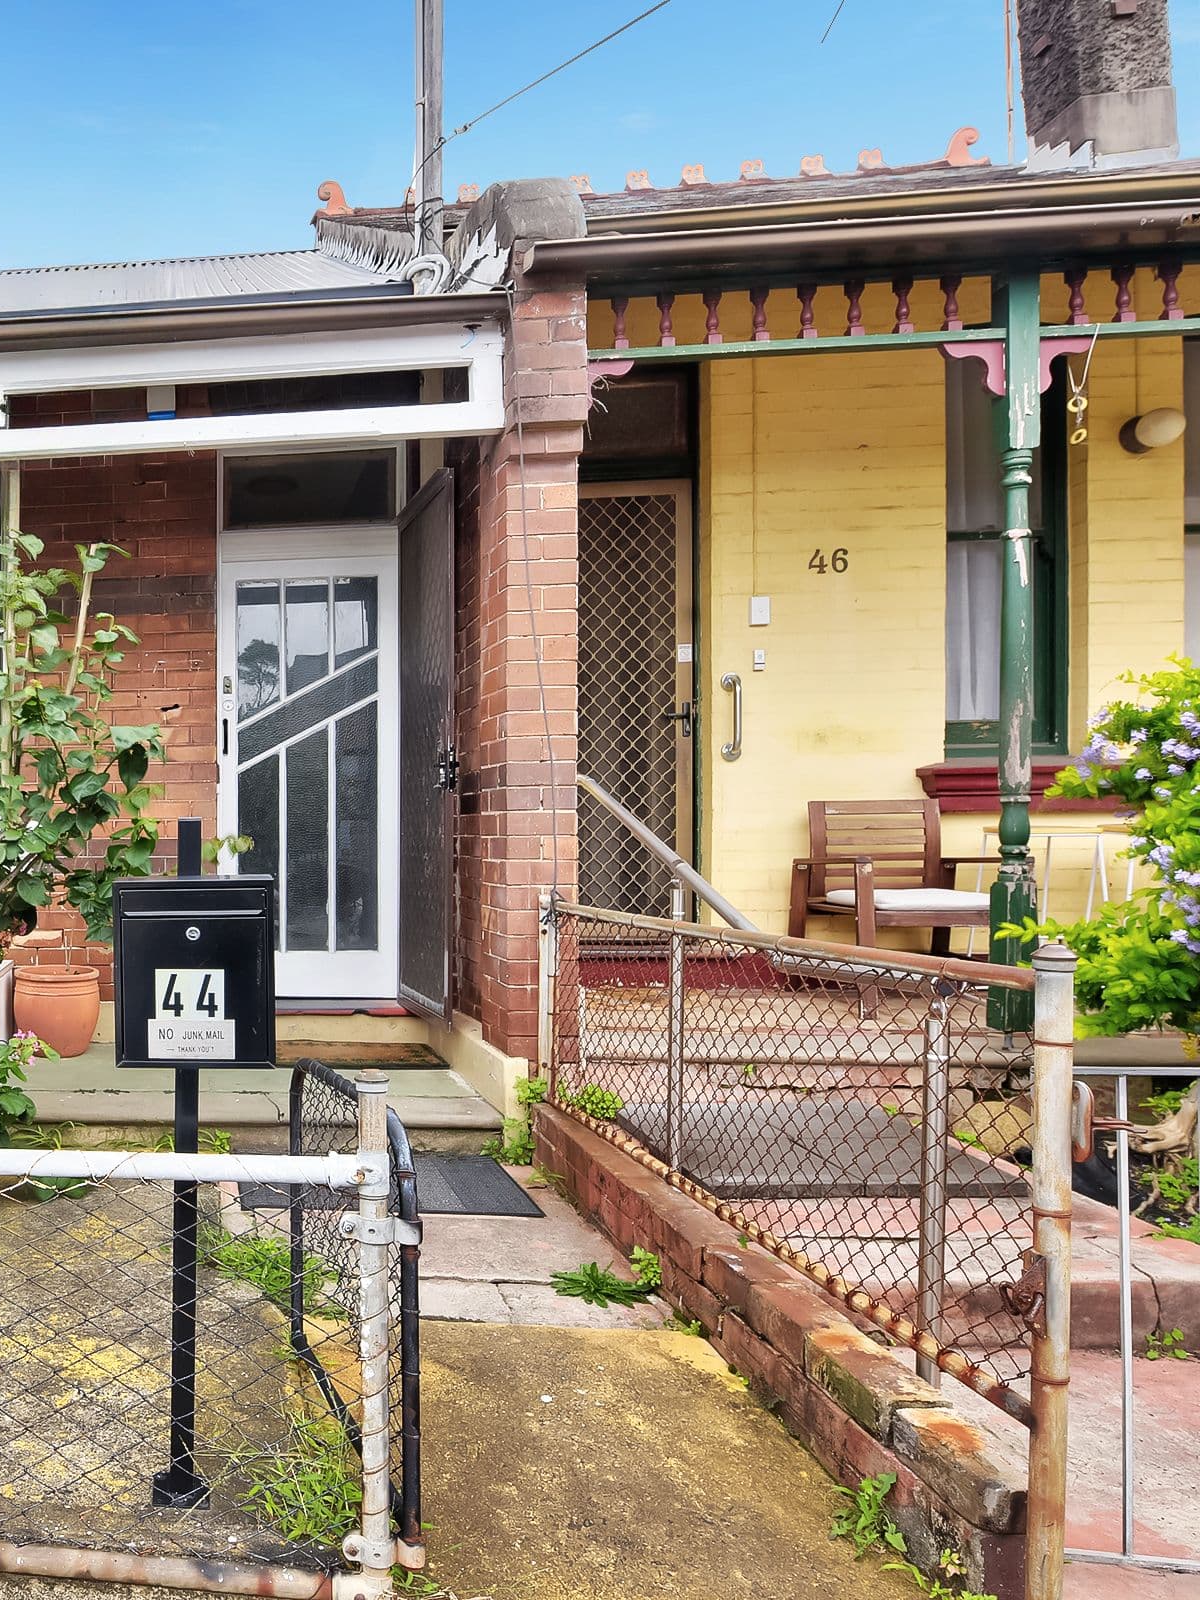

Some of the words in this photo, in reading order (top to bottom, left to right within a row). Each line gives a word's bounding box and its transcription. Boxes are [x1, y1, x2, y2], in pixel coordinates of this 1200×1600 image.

[808, 548, 848, 574] 46
[162, 973, 219, 1018] 44
[158, 1028, 174, 1040] NO
[182, 1031, 204, 1040] JUNK
[205, 1030, 225, 1040] MAIL
